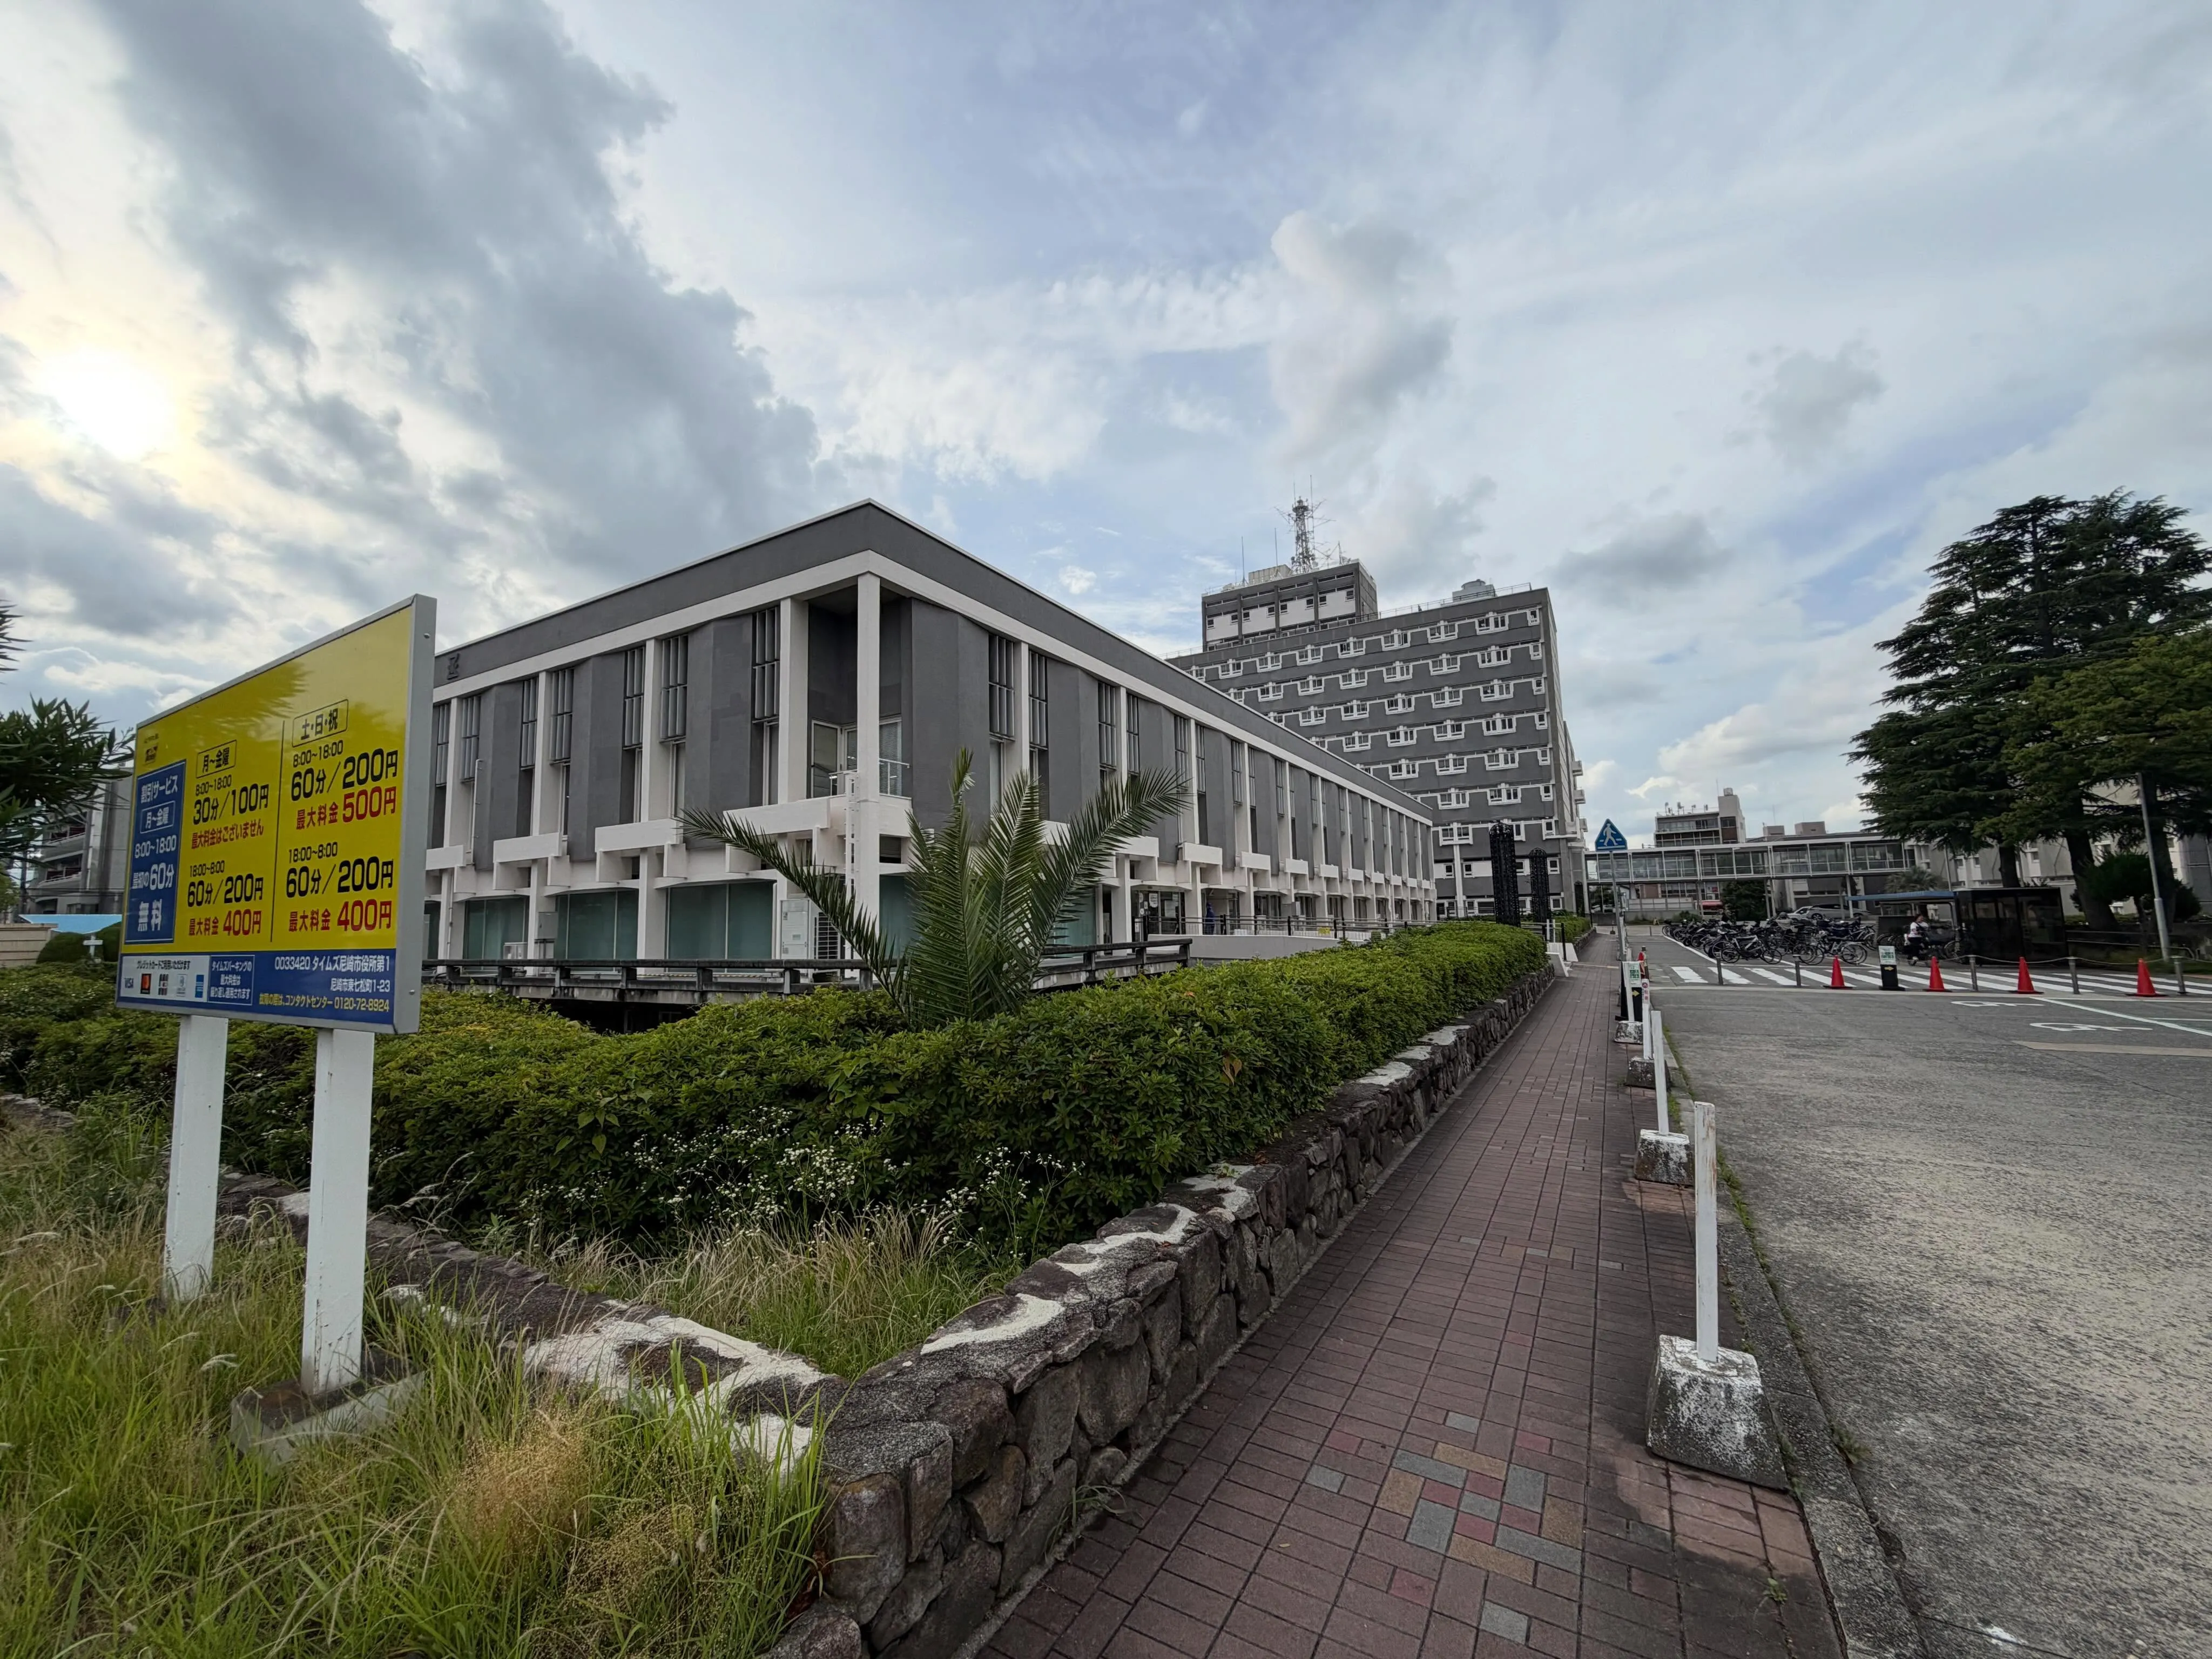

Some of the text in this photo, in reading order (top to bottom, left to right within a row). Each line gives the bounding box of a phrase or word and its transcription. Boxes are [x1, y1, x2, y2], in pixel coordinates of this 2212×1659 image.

[140, 775, 178, 804] 割引サービス
[296, 786, 396, 830] 最大料金 500円
[192, 818, 264, 849] 最大料金はございません
[138, 899, 162, 932] 無料
[189, 909, 261, 936] 最大料金 400円
[288, 899, 392, 932] 最大料金 400円
[275, 955, 389, 972] 0033420 タイムズ尼崎市役所第1
[331, 977, 390, 993] 尼崎市東七松町1-23
[334, 997, 389, 1013] 0120-72-8924
